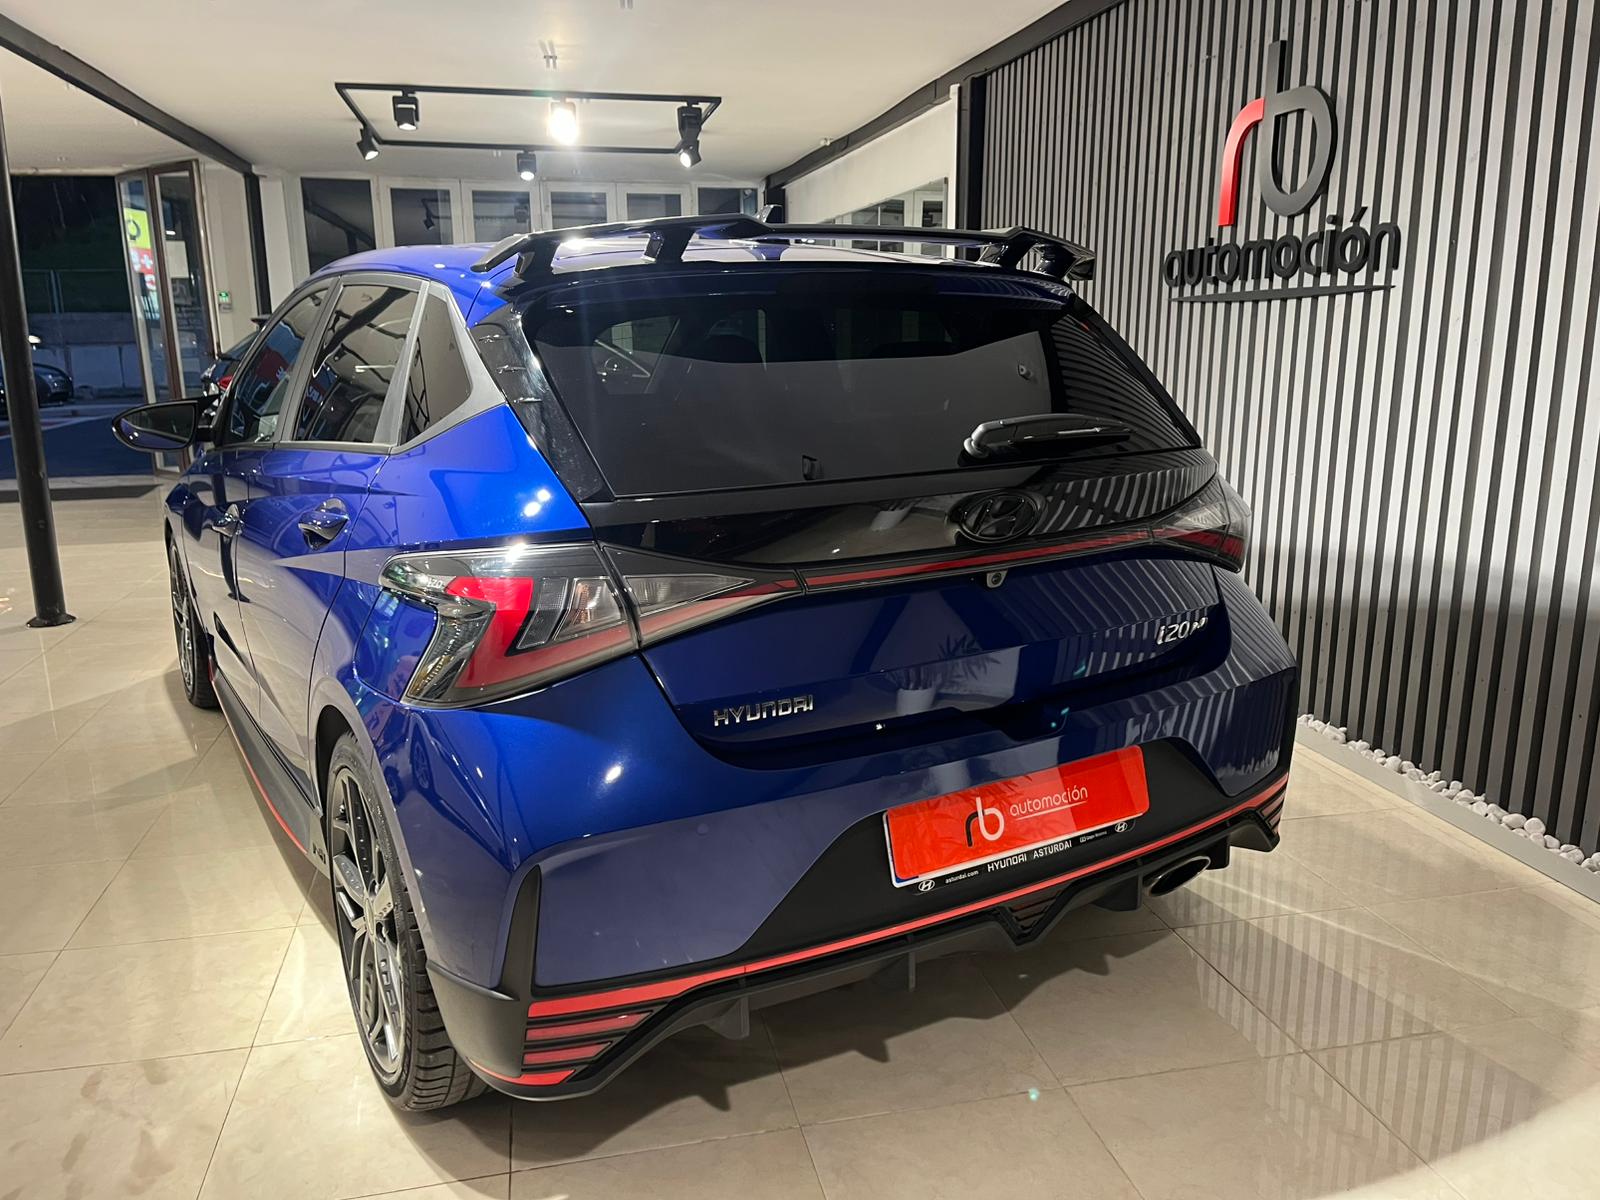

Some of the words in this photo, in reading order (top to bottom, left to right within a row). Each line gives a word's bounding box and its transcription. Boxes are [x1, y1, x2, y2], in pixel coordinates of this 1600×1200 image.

[1164, 206, 1401, 288] automoción
[713, 694, 814, 727] HYUNDAI
[1009, 785, 1089, 816] automoción
[987, 853, 1027, 873] HYUNDAI
[1033, 840, 1073, 859] ASTURDAI
